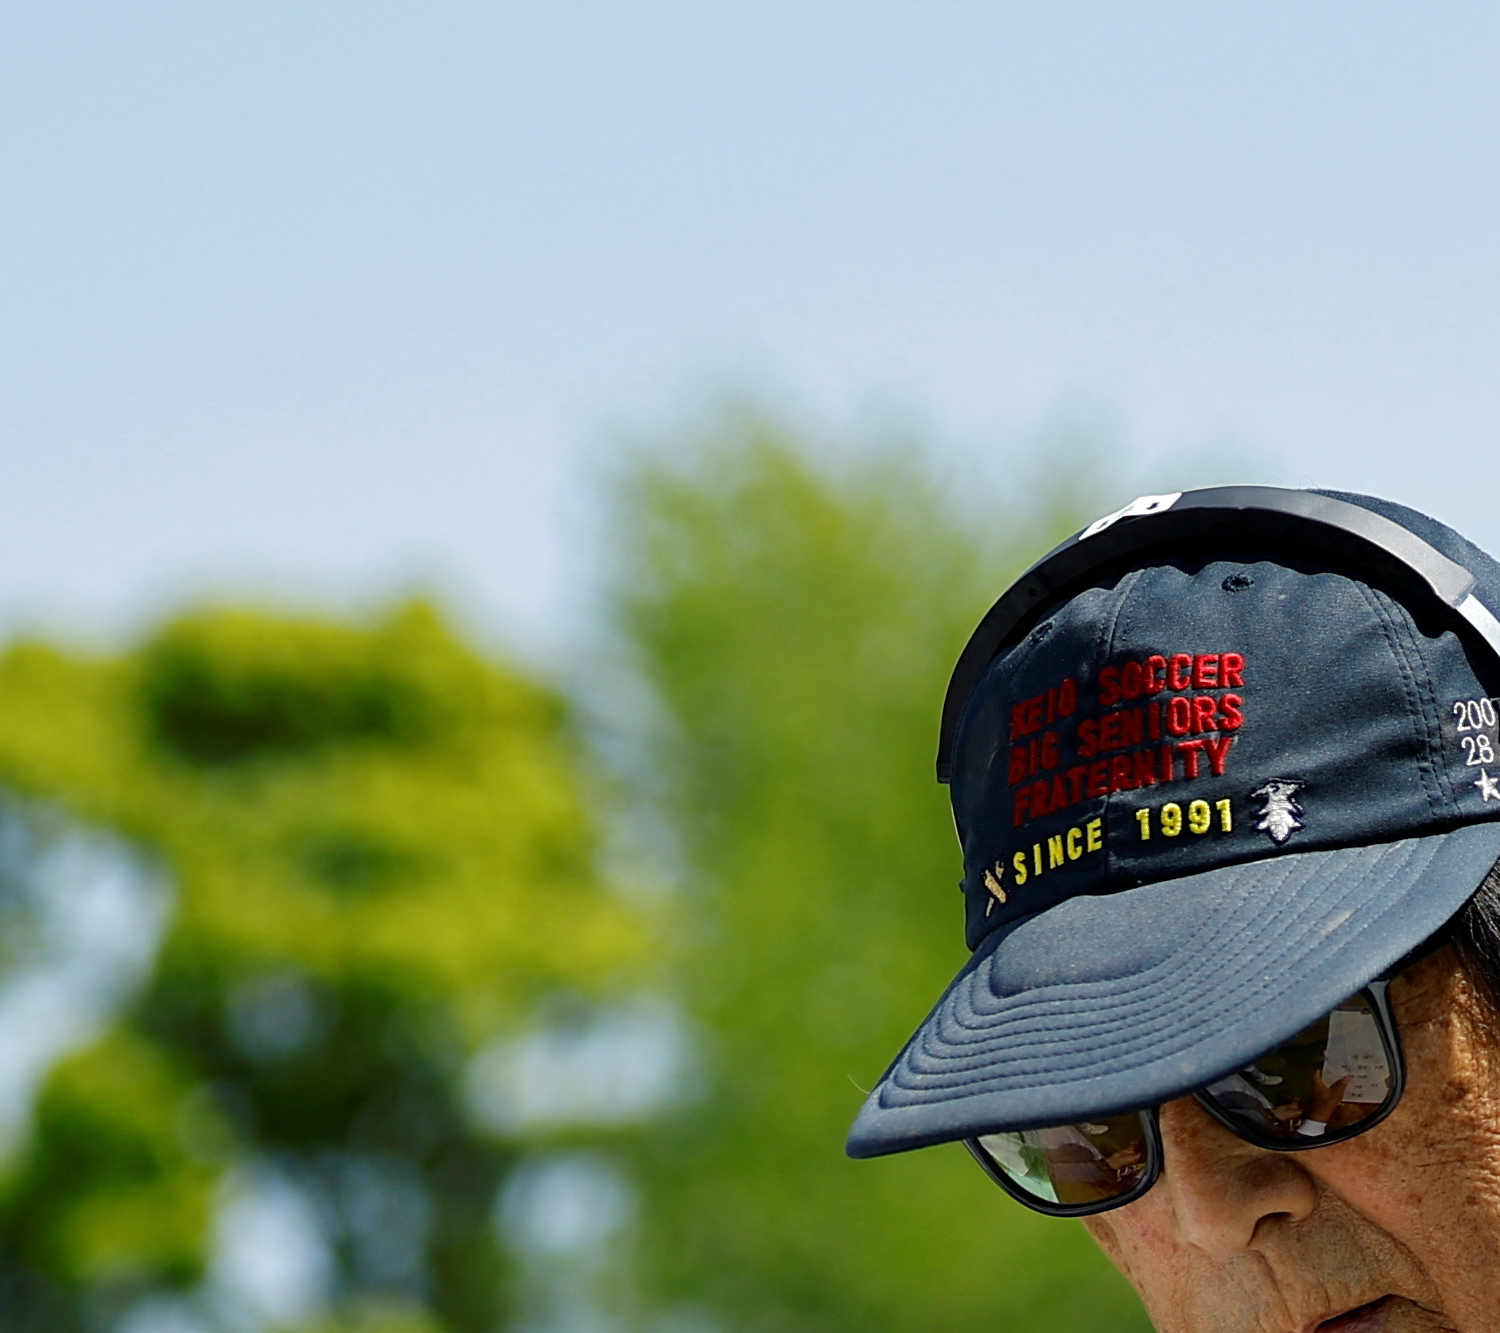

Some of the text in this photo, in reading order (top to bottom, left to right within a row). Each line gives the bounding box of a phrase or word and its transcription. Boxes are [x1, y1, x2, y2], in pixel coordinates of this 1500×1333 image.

[1007, 693, 1246, 787] BIG SENIORS
[1010, 652, 1246, 741] KEIO SOCCER
[1012, 737, 1233, 828] FRATERNITY
[1013, 798, 1233, 885] SINCE 1991
